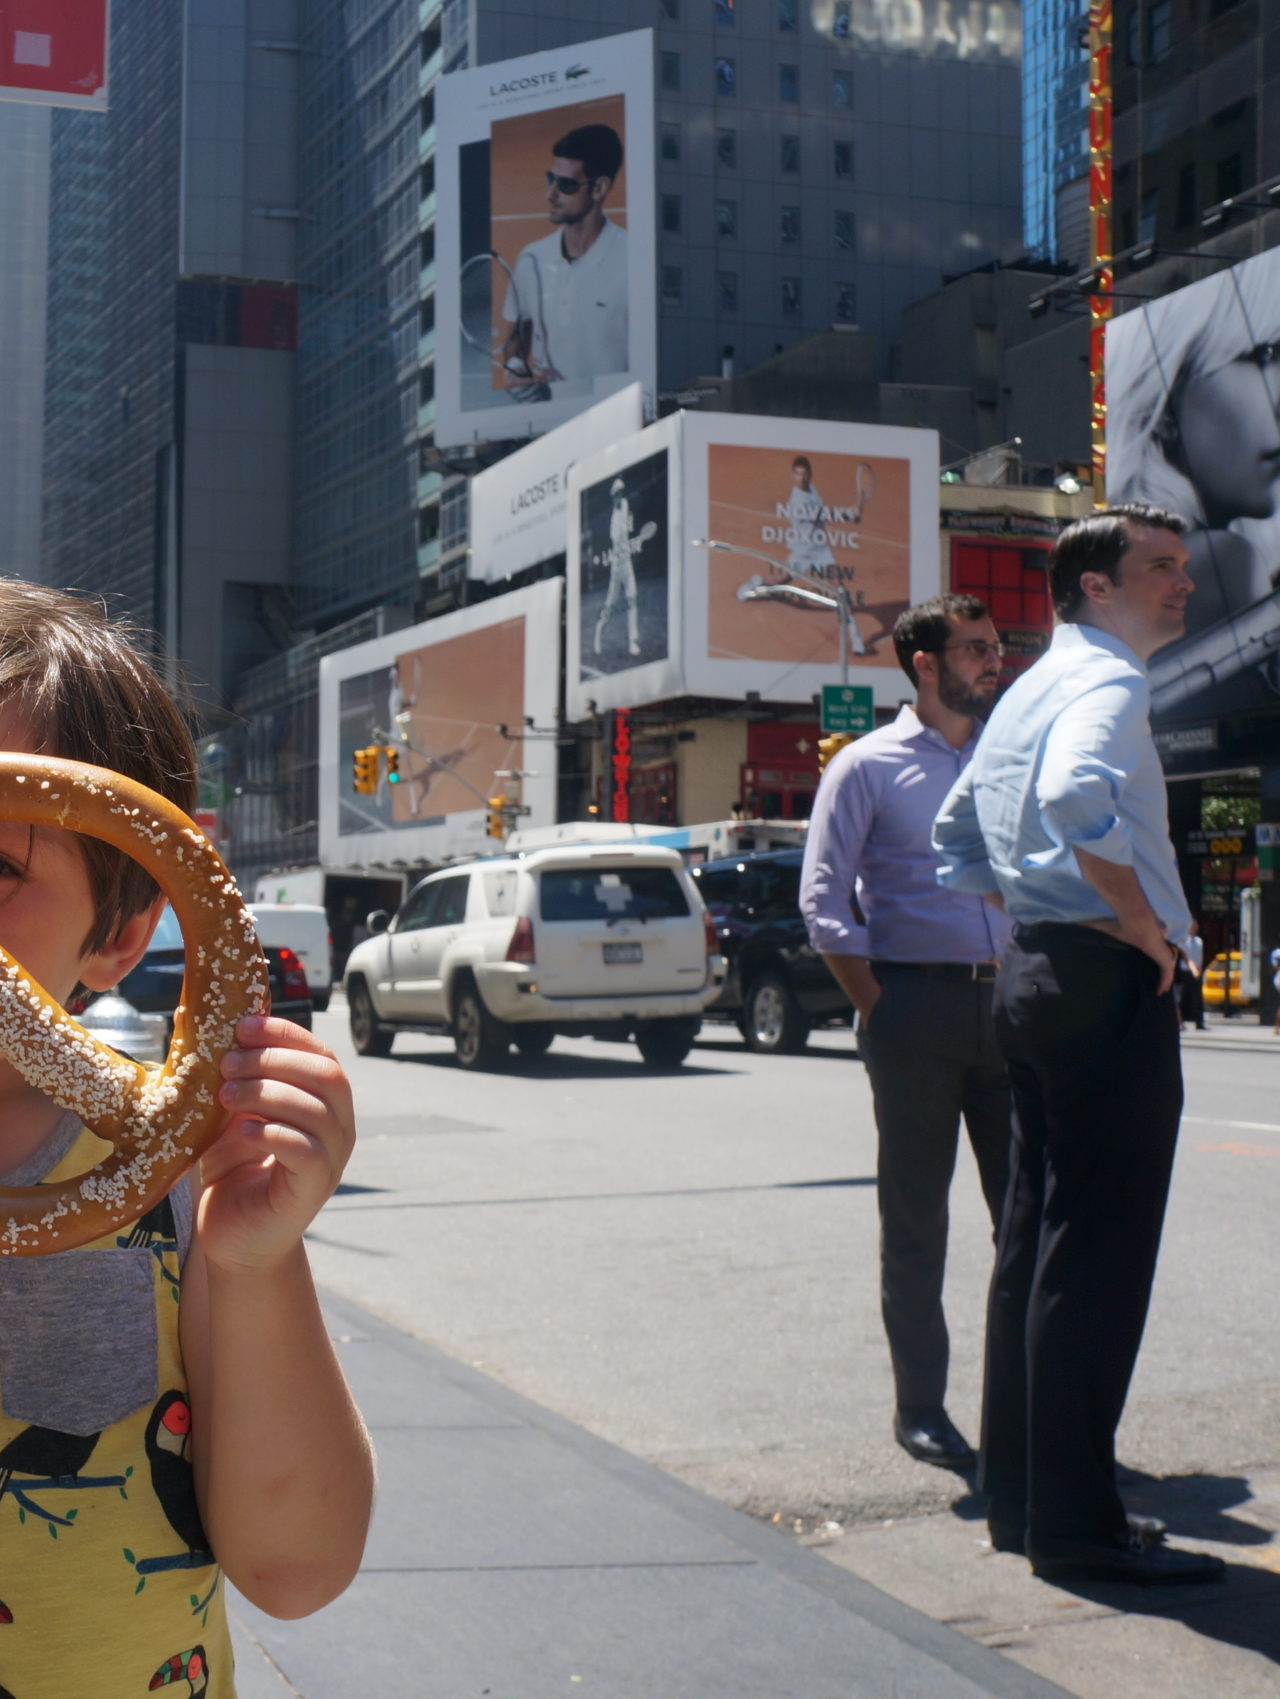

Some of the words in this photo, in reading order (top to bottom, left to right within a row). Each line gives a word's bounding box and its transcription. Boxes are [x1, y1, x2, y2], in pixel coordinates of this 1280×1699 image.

[489, 71, 558, 96] LACOSTE
[510, 473, 559, 515] LACOSTE
[775, 502, 847, 523] NOVAK
[761, 525, 860, 549] DJOKOVIC
[810, 564, 855, 580] NEW
